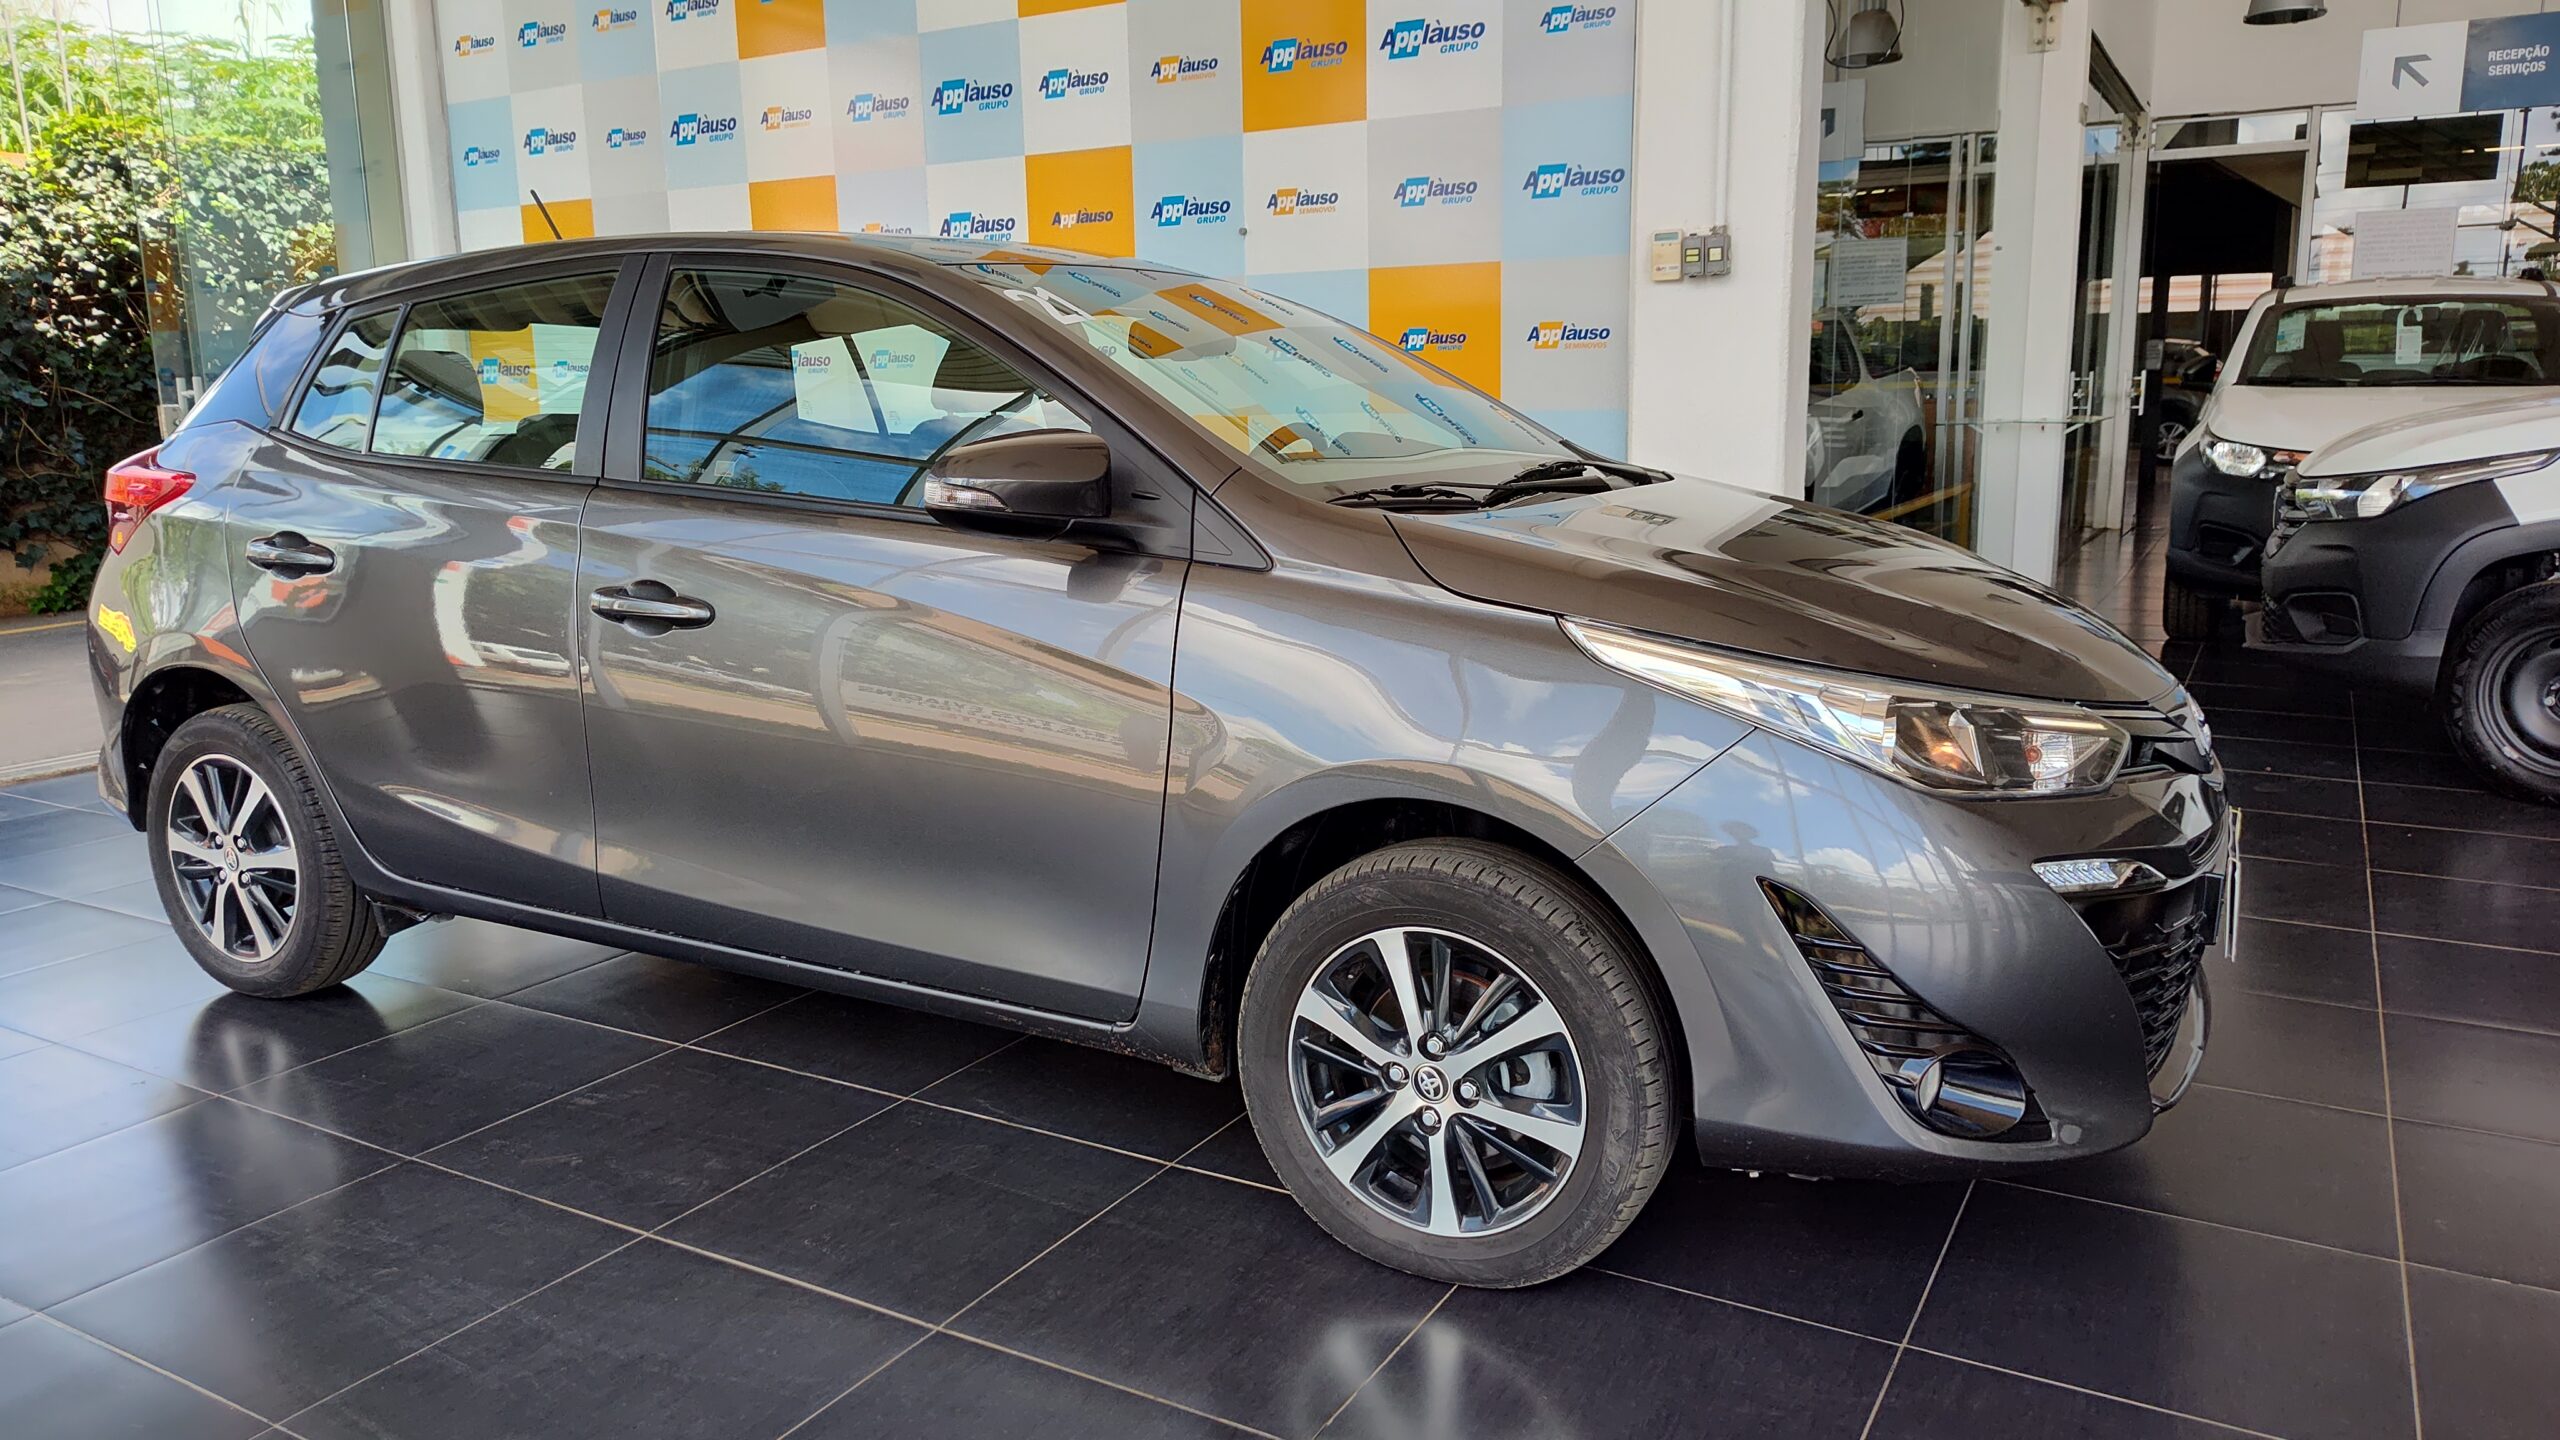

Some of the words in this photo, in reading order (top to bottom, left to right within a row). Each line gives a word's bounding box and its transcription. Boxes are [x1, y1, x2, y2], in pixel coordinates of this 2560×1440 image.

[1539, 4, 1616, 34] Applàuso
[1583, 19, 1611, 30] GRUPO
[1380, 18, 1486, 60] Applàuso
[1440, 40, 1479, 54] GRUPO
[2488, 44, 2550, 62] RECEPÇÃO
[1150, 55, 1218, 84] Applàuso
[1260, 38, 1348, 73] Applàuso
[1310, 57, 1343, 69] GRUPO
[2488, 60, 2547, 76] SERVIÇOS
[931, 78, 1013, 115] Applàuso
[1038, 68, 1109, 99] Applàuso
[1079, 85, 1105, 96] GRUPO
[847, 93, 909, 122] Applàuso
[883, 110, 906, 119] GRUPO
[978, 99, 1009, 111] GRUPO
[523, 127, 576, 155] Applàuso
[670, 113, 737, 146] Applàuso
[709, 132, 734, 143] GRUPO
[1394, 176, 1478, 207] Applàuso
[1523, 163, 1626, 199] Applàuso
[1581, 184, 1619, 196] GRUPO
[1150, 195, 1231, 227] Applàuso
[1266, 188, 1339, 216] Applàuso
[1441, 194, 1473, 205] GRUPO
[940, 211, 1016, 239] Applàuso
[1051, 207, 1114, 229] Applàuso
[1196, 214, 1227, 225] GRUPO
[1398, 327, 1467, 351] Applàuso
[1526, 321, 1610, 350] Applàuso
